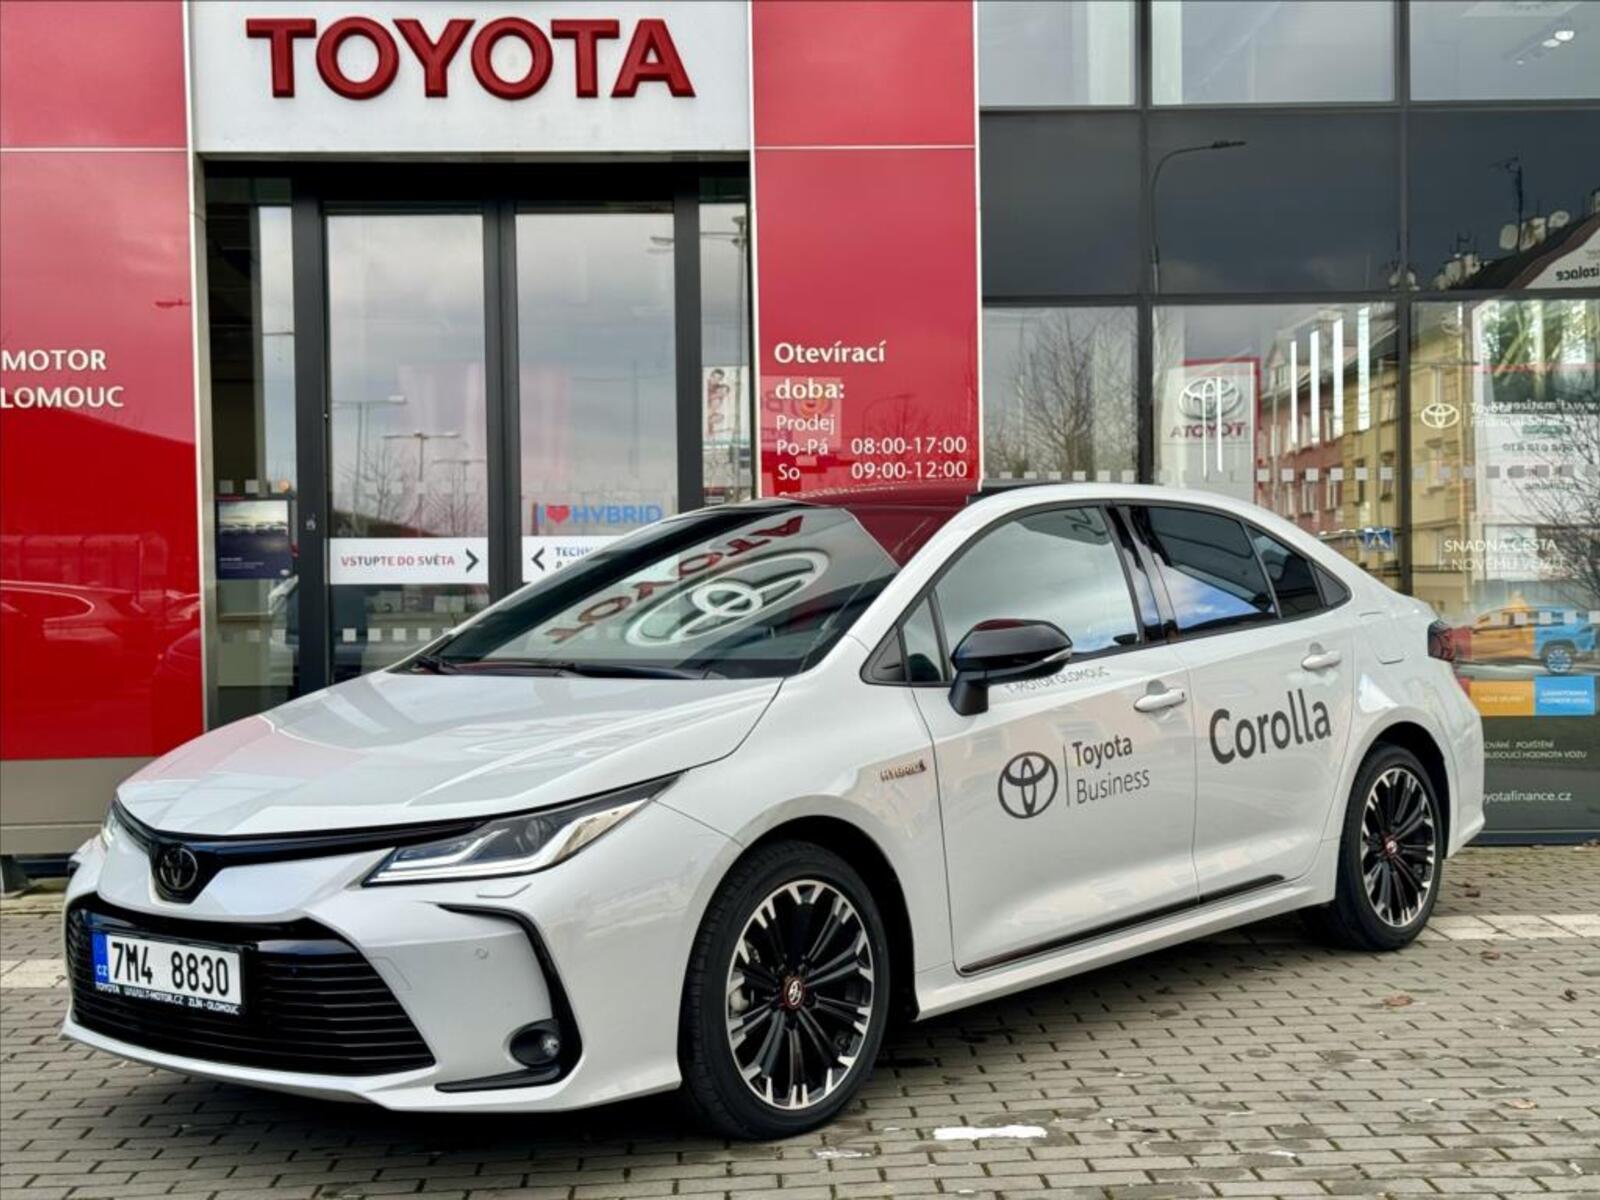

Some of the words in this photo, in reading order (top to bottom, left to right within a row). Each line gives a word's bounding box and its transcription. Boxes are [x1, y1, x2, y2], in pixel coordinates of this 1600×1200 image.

[246, 16, 697, 100] TOYOTA
[2, 349, 107, 371] MOTOR
[774, 340, 887, 363] Otevírací
[0, 386, 124, 409] LOMOUC
[775, 377, 845, 400] doba:
[776, 414, 835, 435] Prodej
[776, 438, 829, 456] Po-Pá
[851, 436, 968, 455] 08:00-17:00
[778, 463, 801, 481] So
[851, 461, 968, 479] 09:00-12:00
[571, 504, 663, 524] HYBRID
[341, 555, 396, 567] VSTUPTE
[397, 556, 415, 566] DO
[556, 546, 598, 558] TECHN
[1209, 688, 1332, 765] Corolla
[1072, 734, 1133, 768] Toyota
[1076, 767, 1150, 804] Business
[96, 964, 108, 976] CZ
[112, 942, 153, 984] 7M4
[171, 951, 229, 996] 8830
[96, 982, 120, 994] TOYOTA
